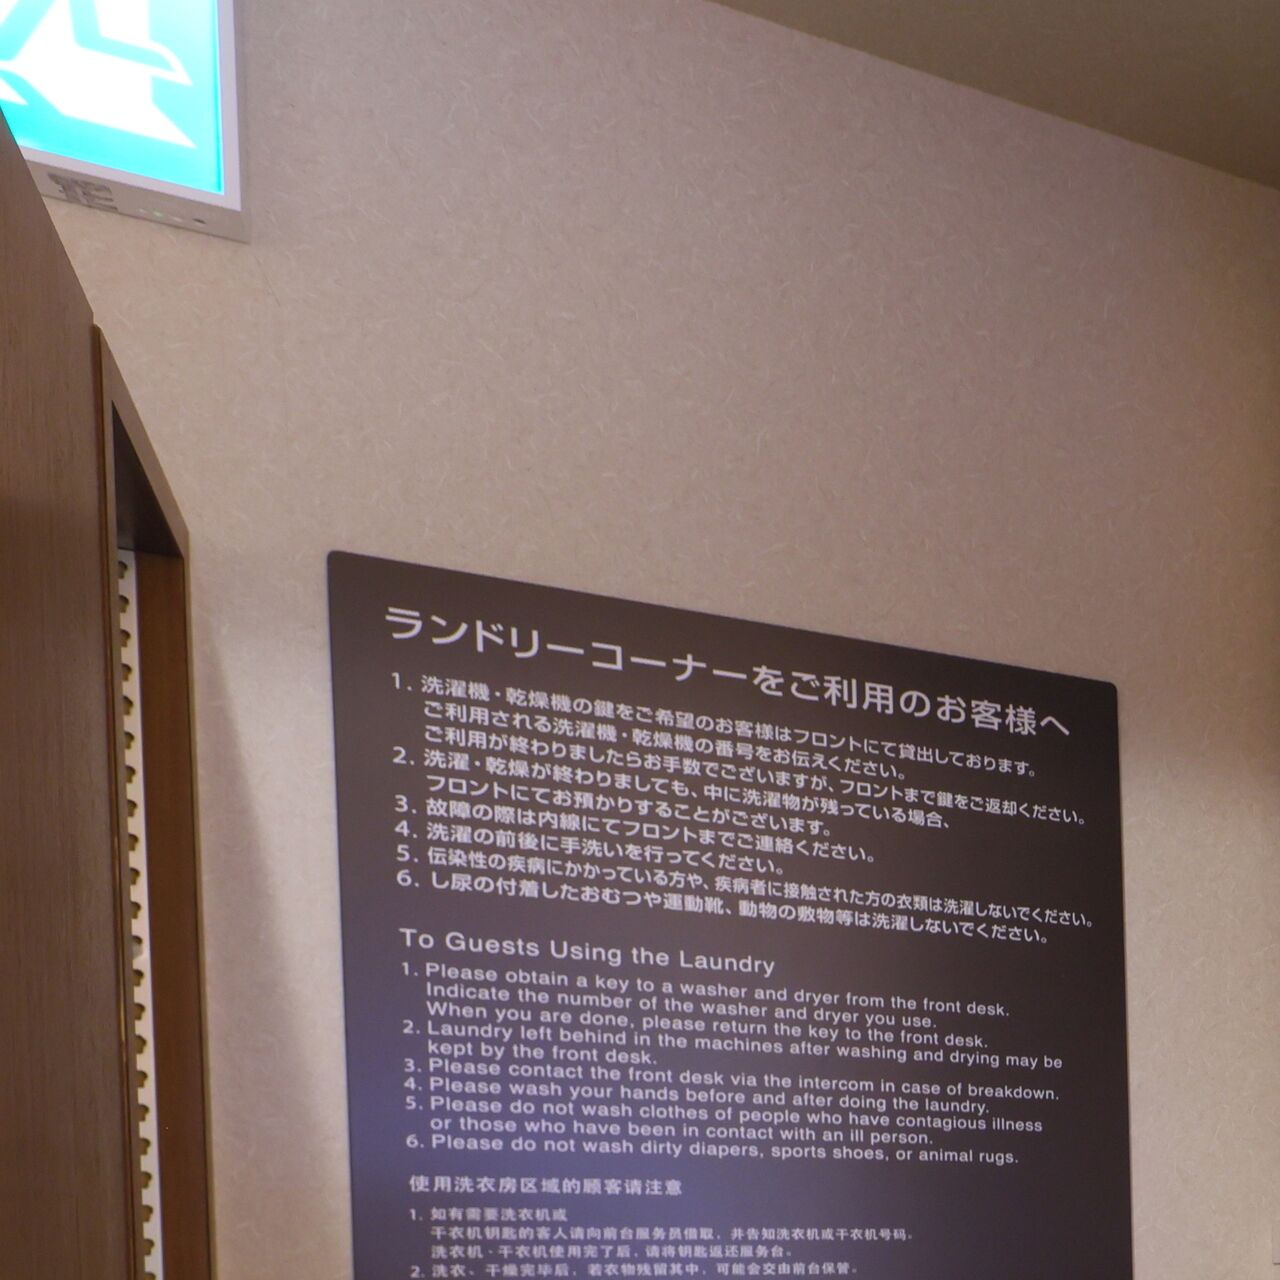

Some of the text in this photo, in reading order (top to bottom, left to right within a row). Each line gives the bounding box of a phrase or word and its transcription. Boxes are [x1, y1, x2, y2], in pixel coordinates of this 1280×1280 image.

[385, 606, 1071, 737] ランドリーコーナーをご利用のお客様へ
[391, 672, 413, 691] 1.
[393, 746, 414, 765] 2.
[395, 795, 874, 862] 3. 故障の際は内線にてフロントまでご連絡ください。
[426, 774, 832, 837] フロントにてお預かりすることがございます。
[395, 820, 784, 875] 4. 洗濯の前後に手洗いを行ってください。
[397, 845, 418, 863] 5.
[397, 869, 419, 887] 6.
[399, 928, 775, 978] To Guests Using the Laundry
[402, 963, 1010, 1017] 1. Please obtain a key to a washer and dryer from the front desk.
